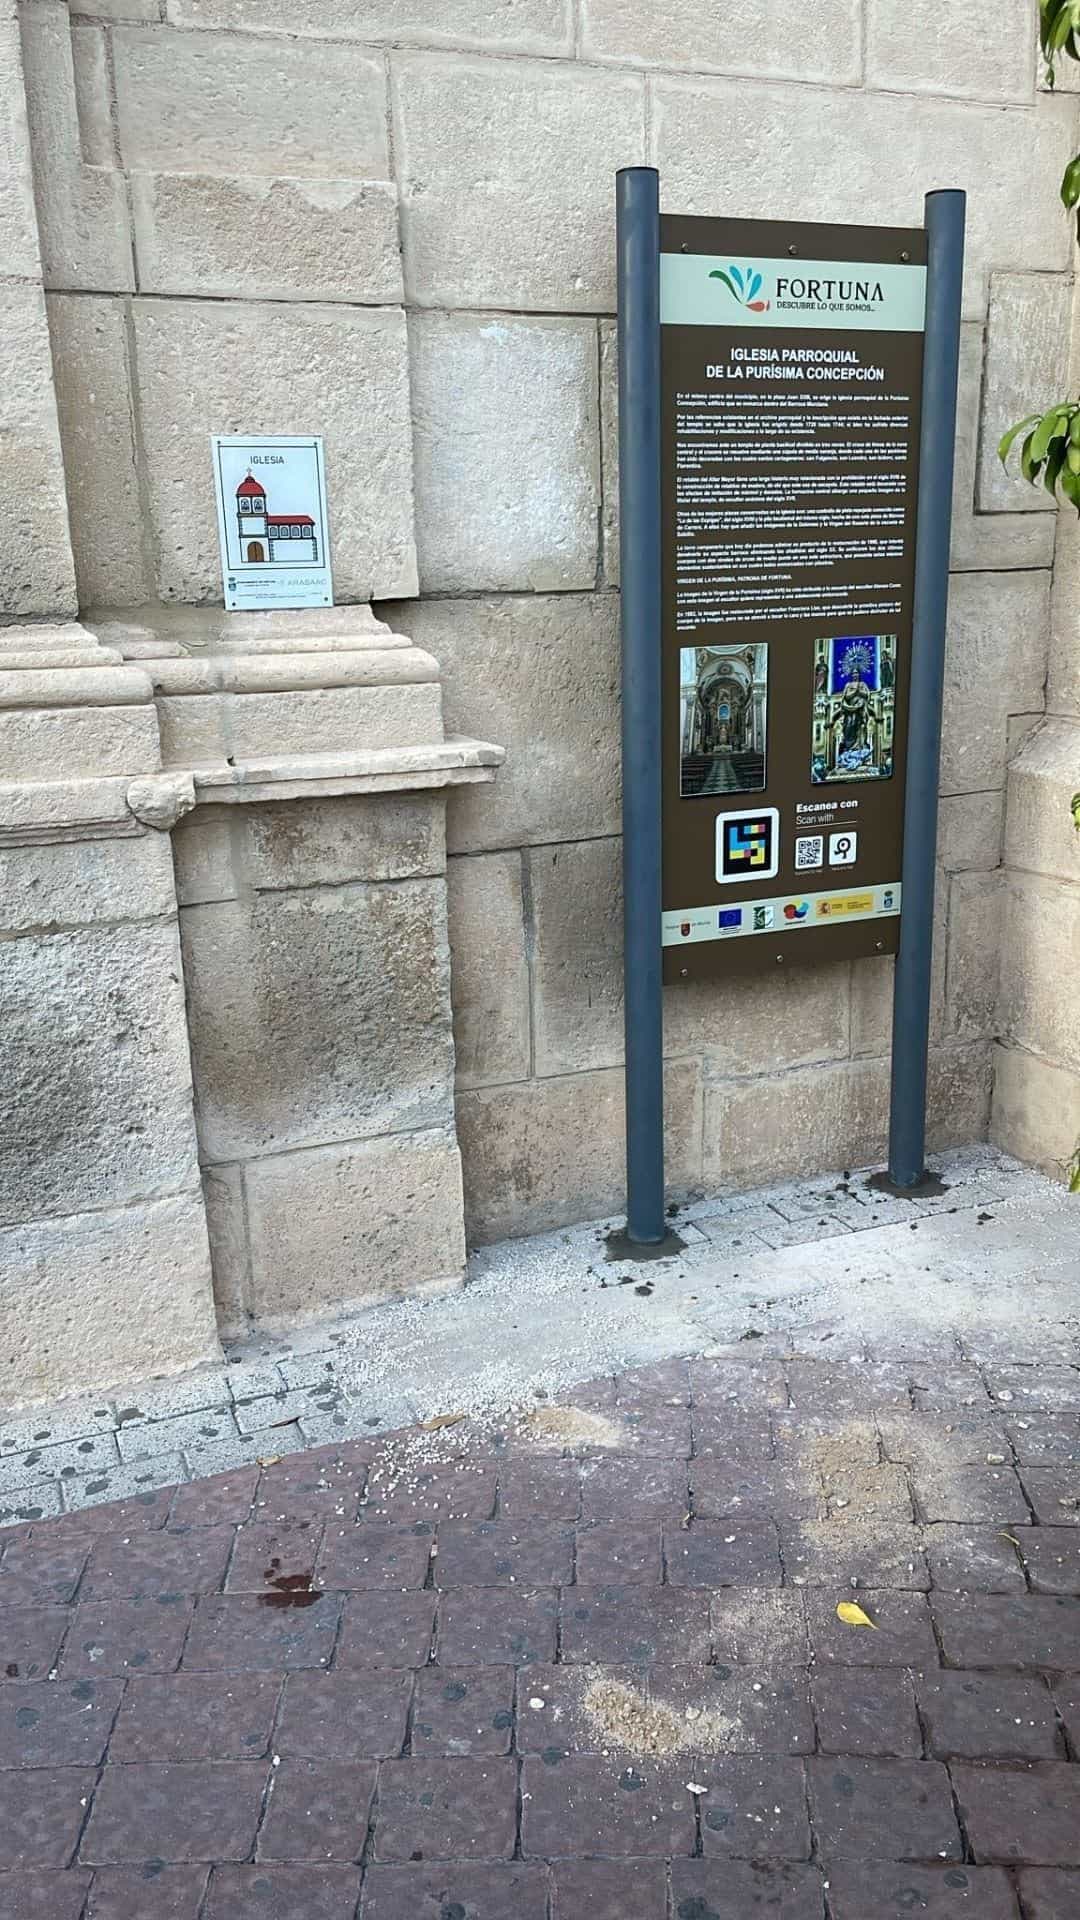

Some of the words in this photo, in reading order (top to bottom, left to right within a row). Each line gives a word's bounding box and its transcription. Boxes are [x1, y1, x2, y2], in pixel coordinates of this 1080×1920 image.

[776, 278, 884, 302] FORTUNA
[776, 301, 816, 310] DESCUBRE
[817, 302, 828, 310] LO
[829, 303, 844, 311] QUE
[730, 348, 779, 361] IGLESIA
[782, 349, 860, 363] PARROQUIAL
[706, 365, 724, 378] DE
[727, 366, 743, 379] LA
[746, 364, 803, 380] PURÍSIMA
[806, 365, 885, 381] CONCEPCIÓN
[250, 455, 285, 464] IGLESIA
[796, 802, 838, 813] Escanea
[840, 800, 858, 809] con
[796, 815, 816, 825] Scan
[818, 814, 834, 823] with
